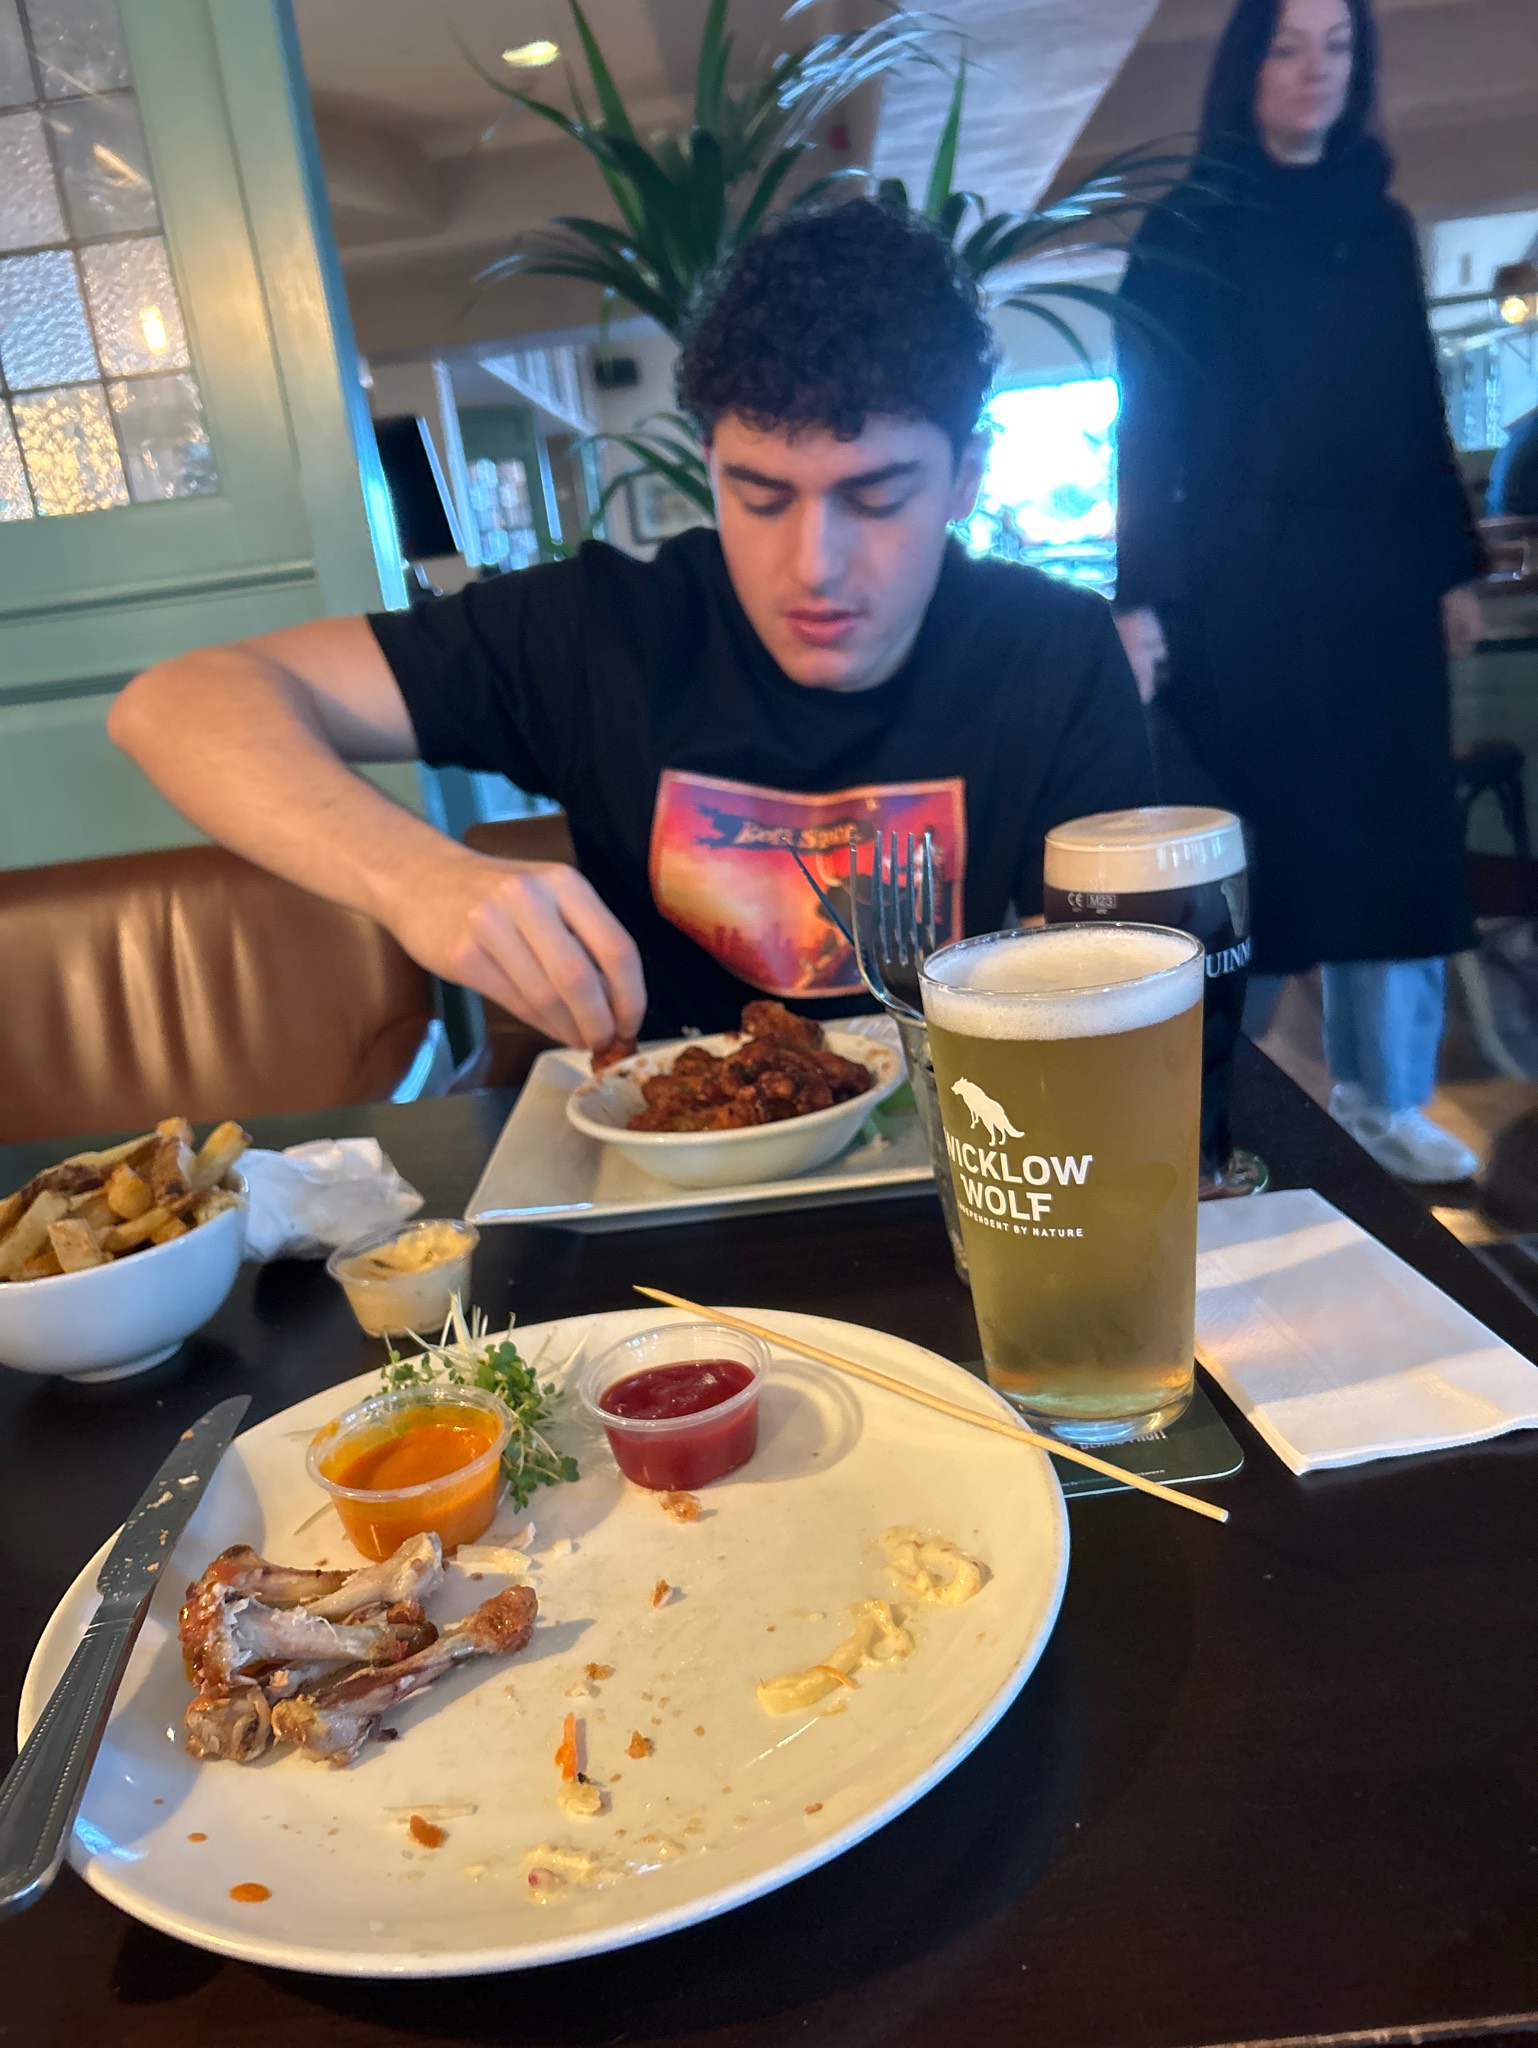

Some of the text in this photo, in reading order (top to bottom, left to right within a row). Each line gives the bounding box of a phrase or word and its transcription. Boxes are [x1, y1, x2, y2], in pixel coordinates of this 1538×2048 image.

[1205, 936, 1250, 978] UINN
[943, 1126, 1093, 1186] WICKLOW
[960, 1173, 1052, 1222] WOLF
[1013, 1225, 1028, 1235] BY
[1032, 1227, 1084, 1238] NATURE
